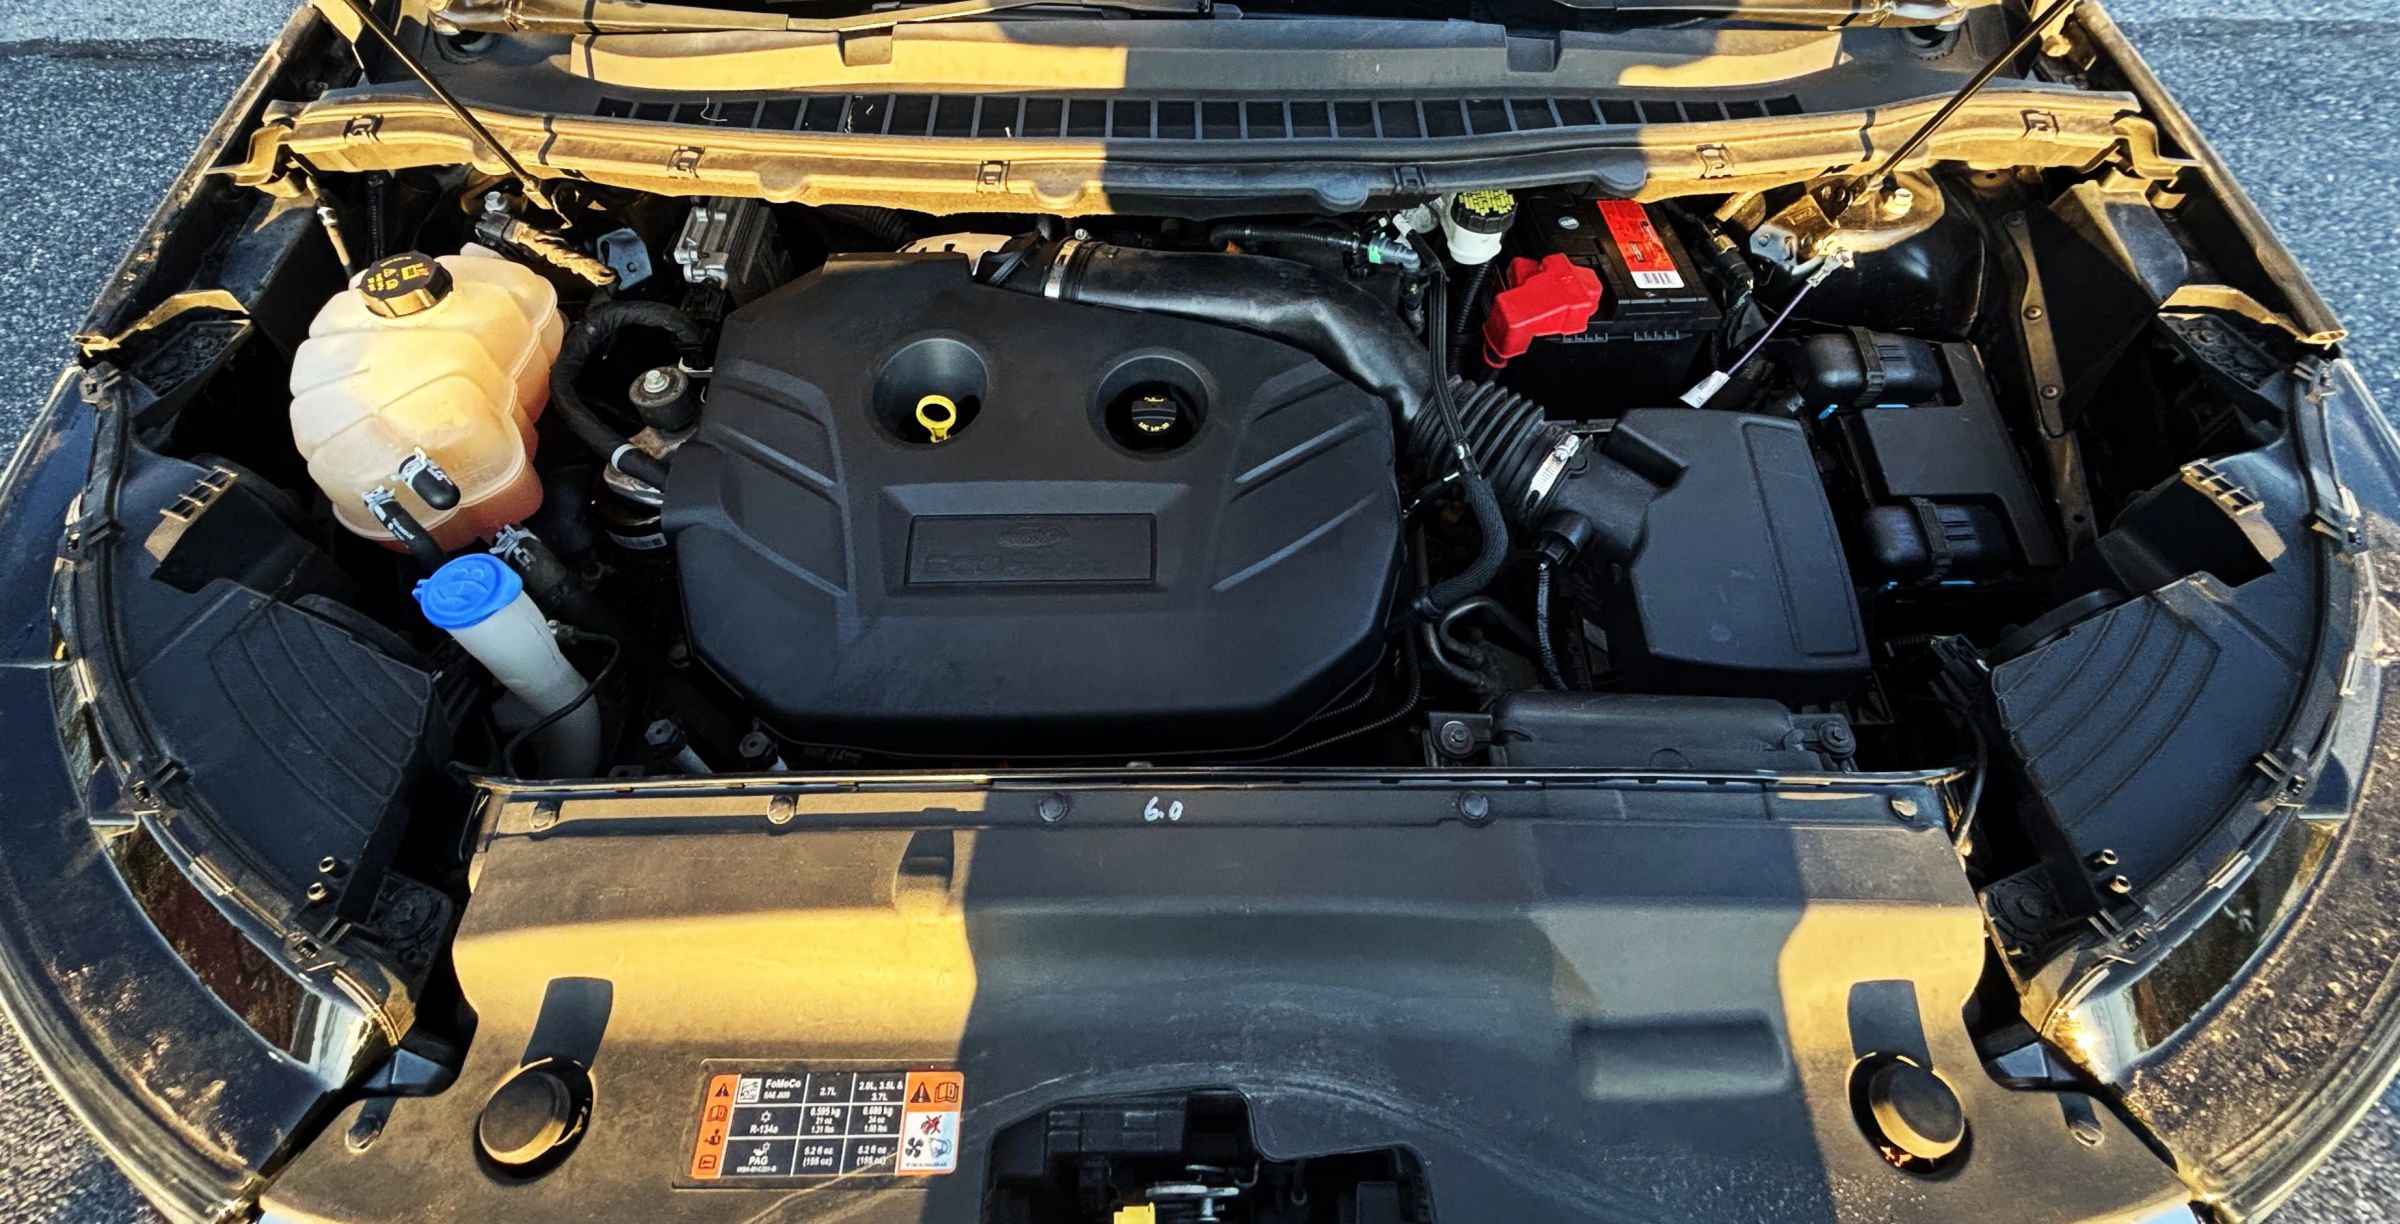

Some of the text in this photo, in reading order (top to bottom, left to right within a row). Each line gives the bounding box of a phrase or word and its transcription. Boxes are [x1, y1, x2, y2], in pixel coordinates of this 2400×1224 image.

[1144, 796, 1183, 821] 6.0
[765, 1079, 801, 1089] FoMoCo
[820, 1087, 836, 1096] 2.7L
[750, 1124, 778, 1134] R-134a
[748, 1156, 768, 1165] PAG
